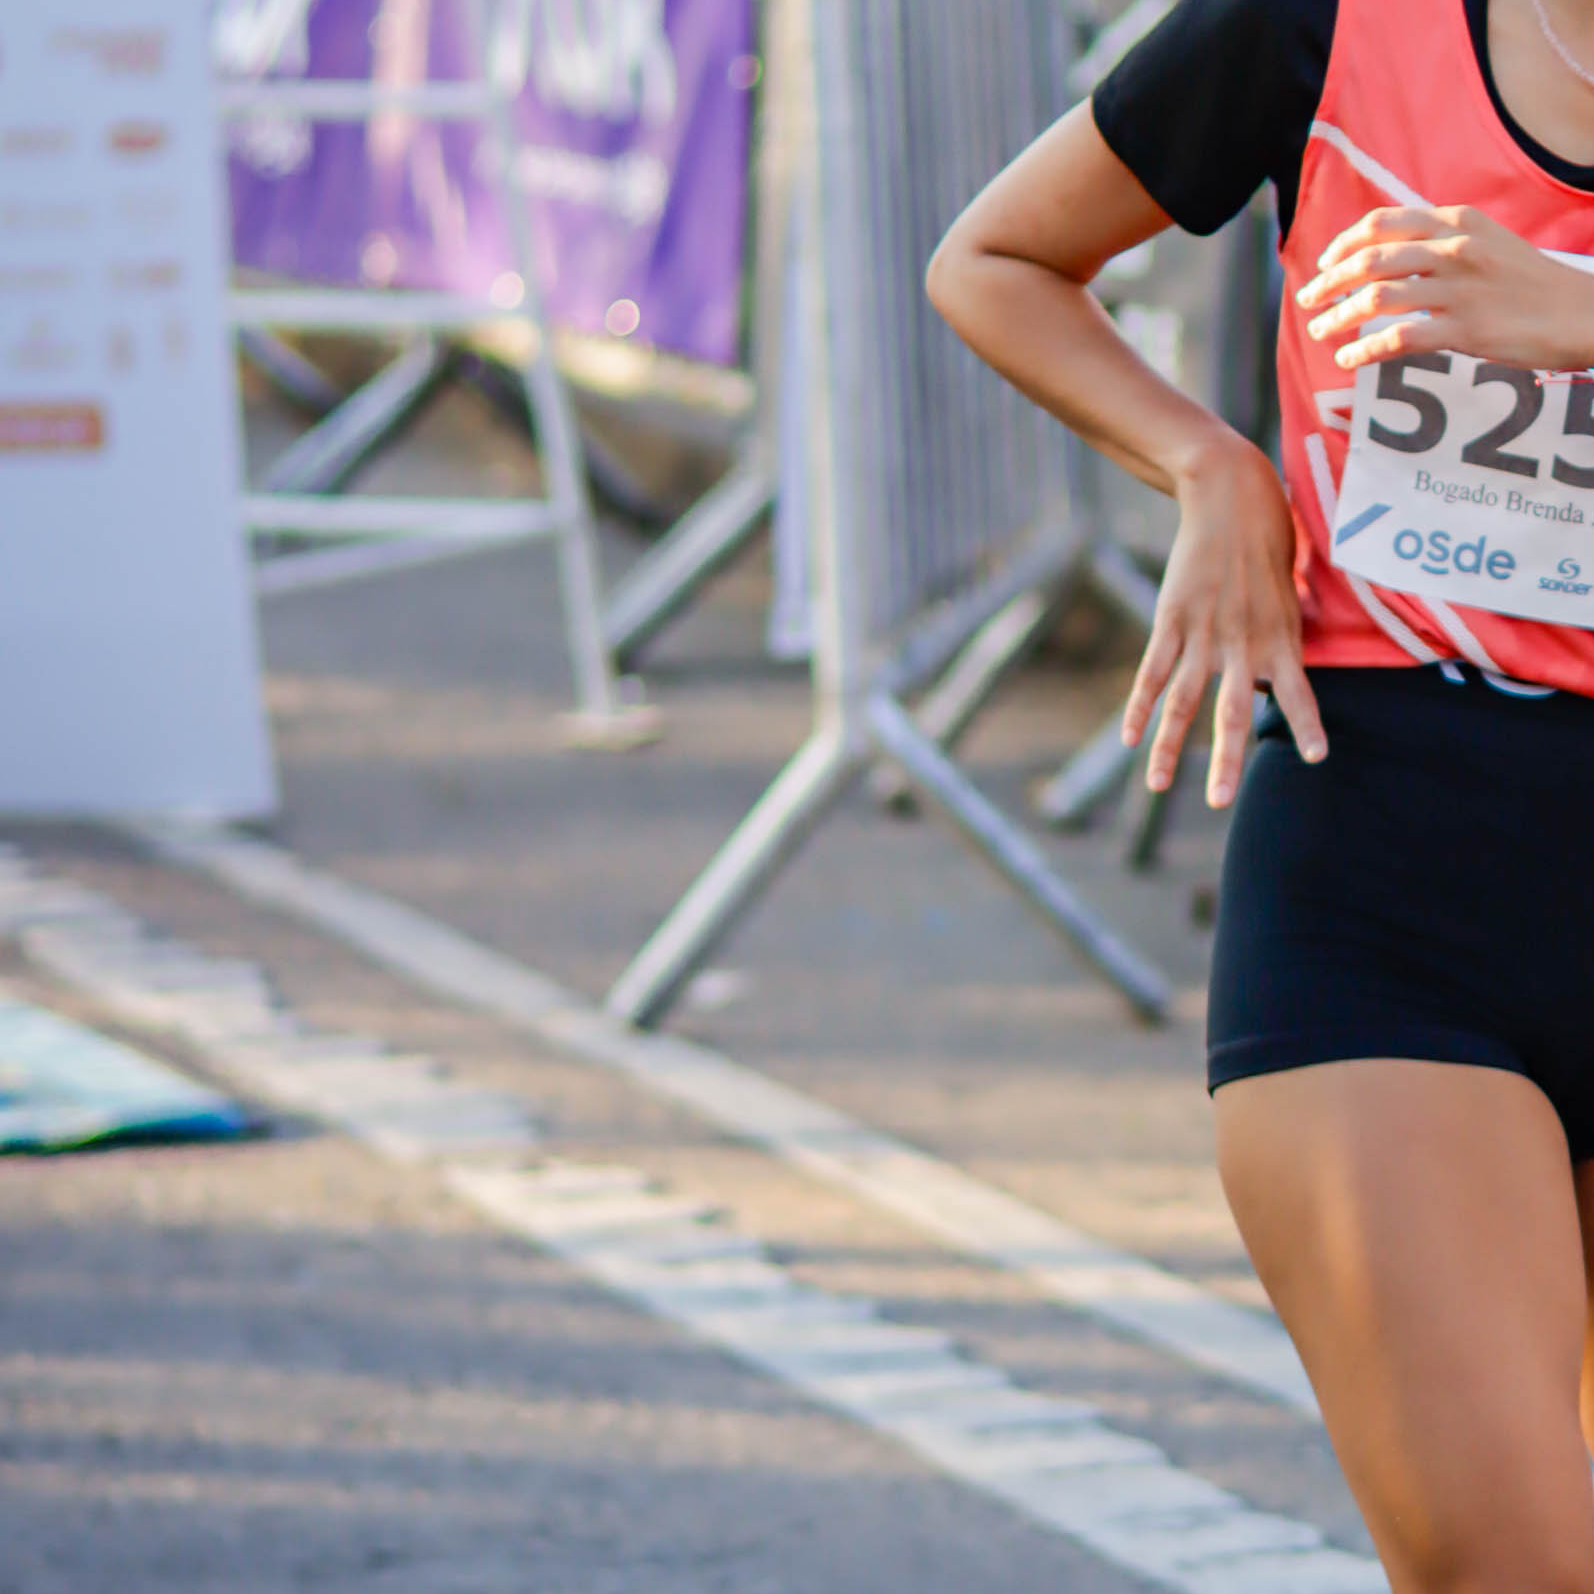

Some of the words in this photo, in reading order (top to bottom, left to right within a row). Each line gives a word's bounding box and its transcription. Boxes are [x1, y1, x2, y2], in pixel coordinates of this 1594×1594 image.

[1414, 469, 1498, 506] Bogado
[1505, 490, 1585, 524] Brenda
[1392, 528, 1517, 580] osde
